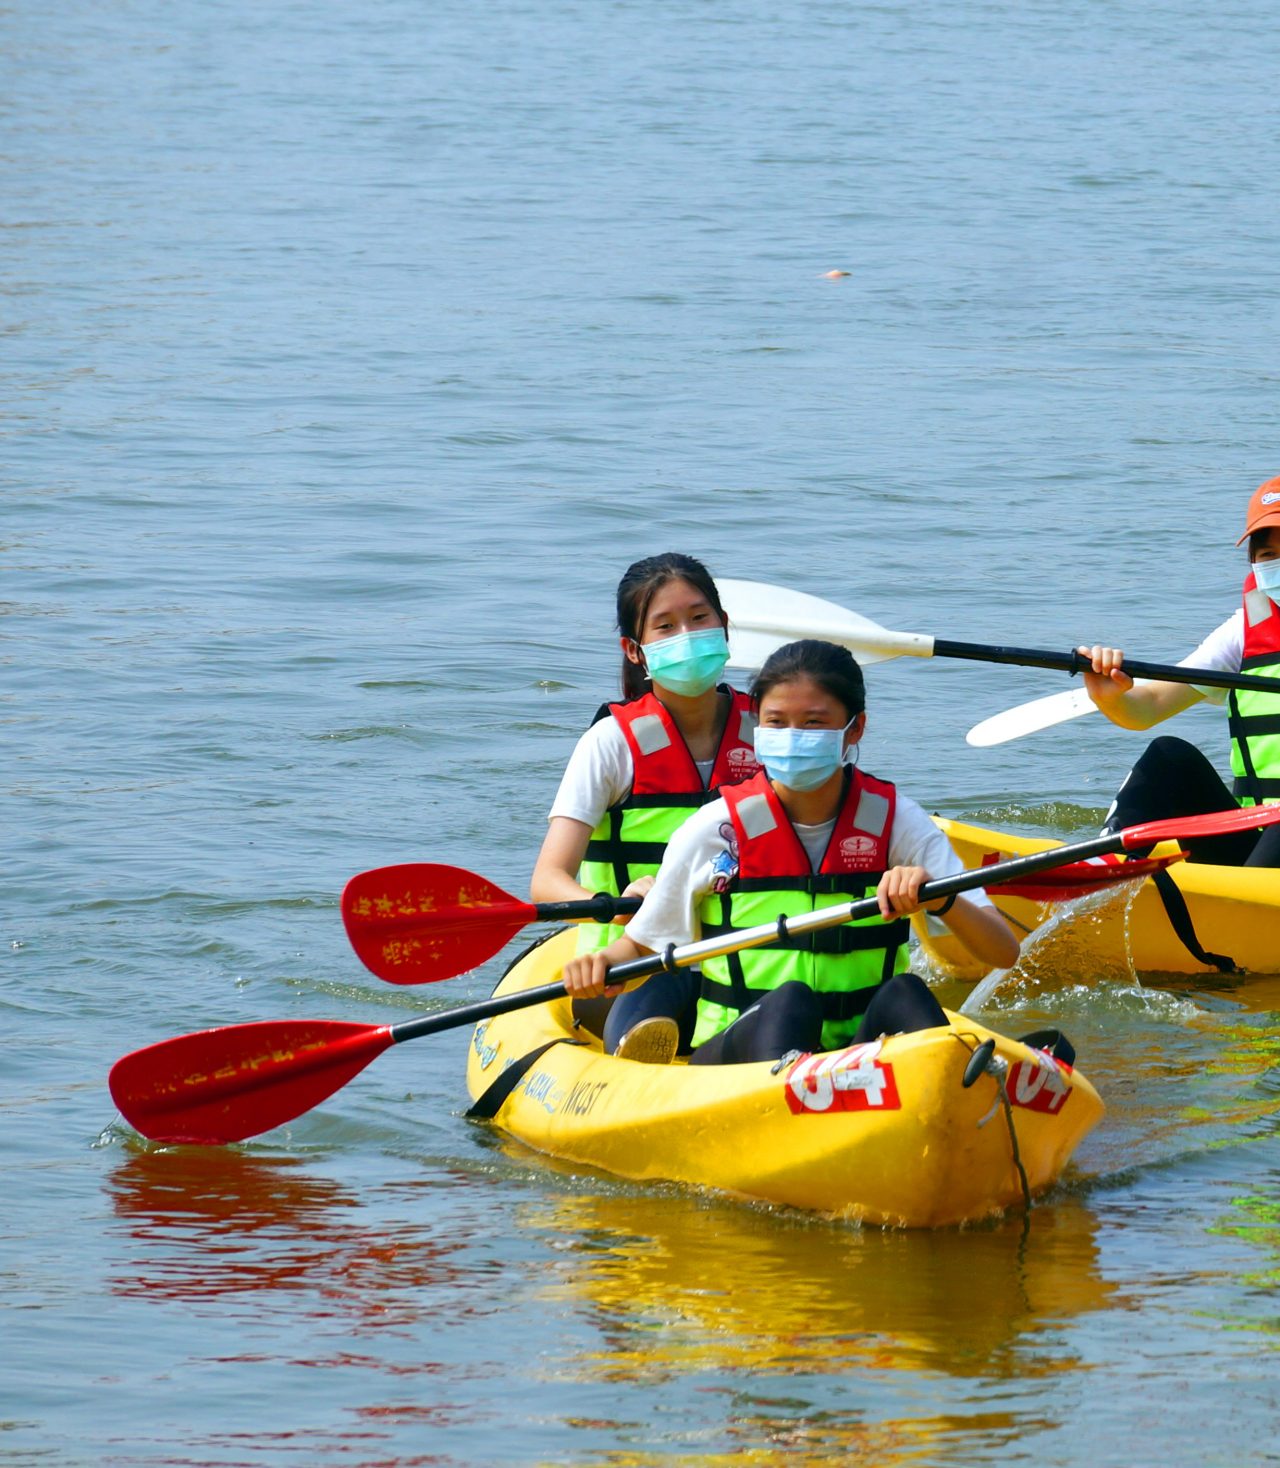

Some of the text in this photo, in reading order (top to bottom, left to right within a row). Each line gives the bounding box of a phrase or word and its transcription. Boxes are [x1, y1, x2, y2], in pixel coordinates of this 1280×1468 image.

[560, 1080, 608, 1116] NKUST
[778, 1038, 888, 1112] 04
[1014, 1043, 1071, 1110] 04
